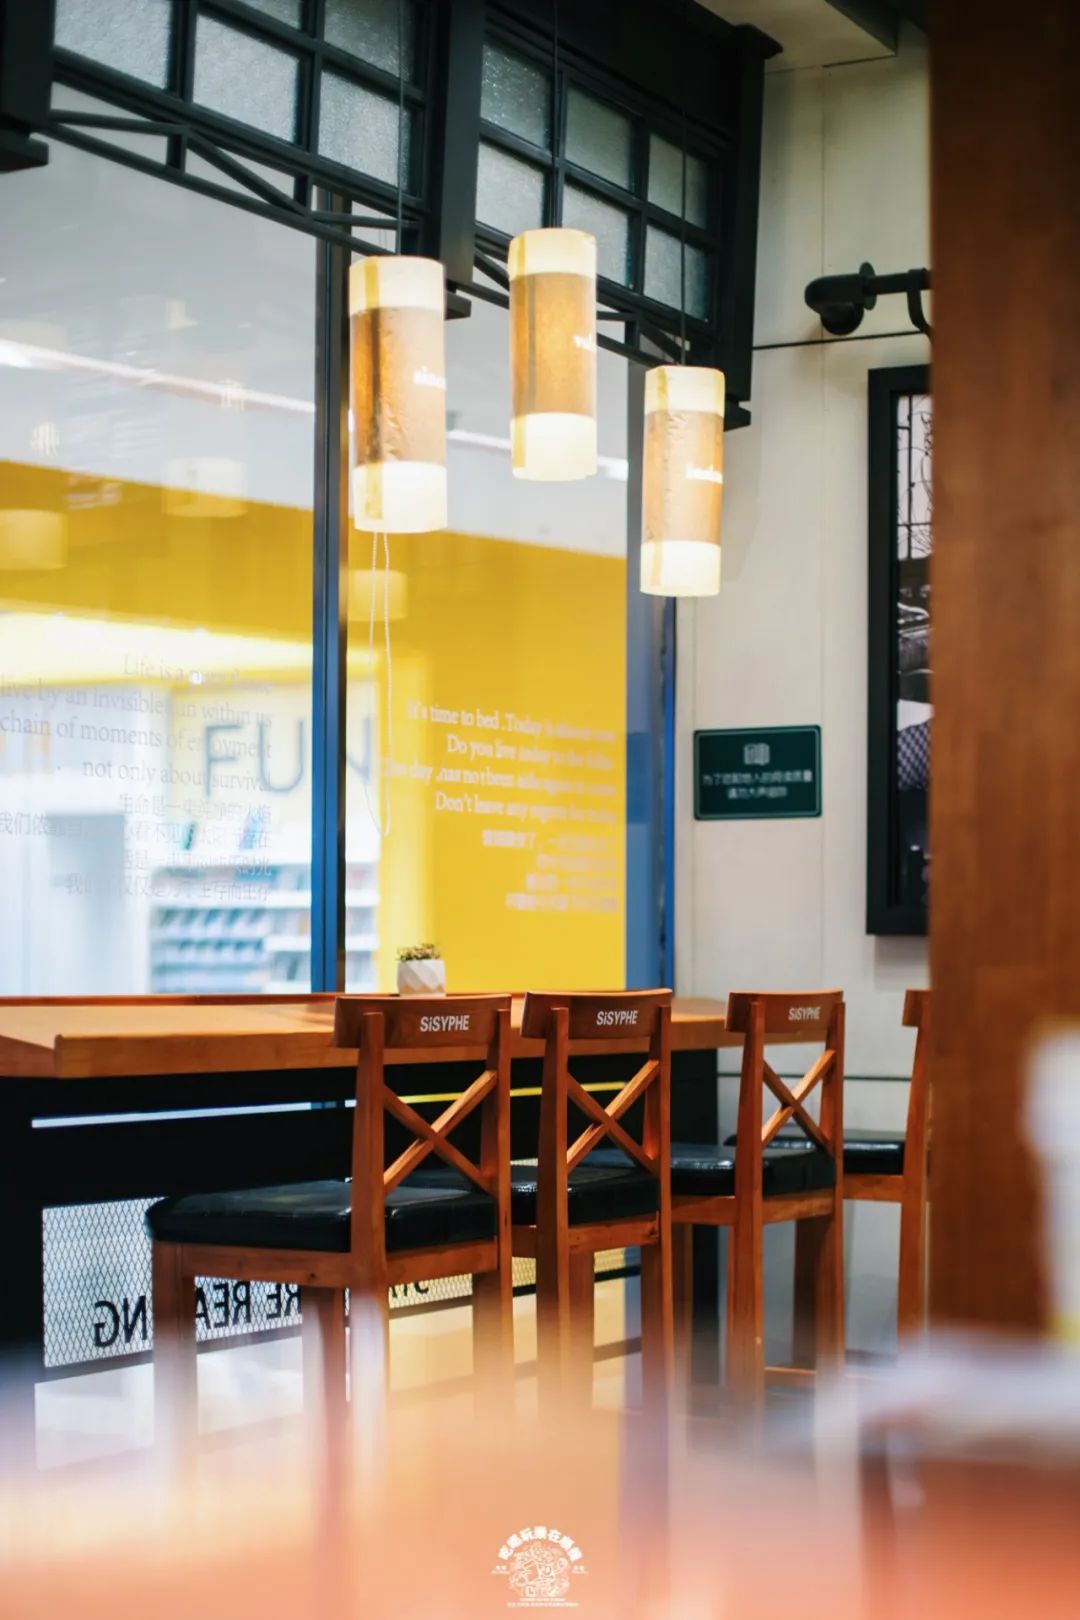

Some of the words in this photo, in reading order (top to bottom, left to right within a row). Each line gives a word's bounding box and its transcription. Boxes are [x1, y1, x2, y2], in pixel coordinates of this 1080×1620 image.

[37, 678, 60, 710] by
[65, 690, 87, 706] an
[93, 686, 164, 715] invisible
[0, 709, 51, 736] chain
[56, 715, 79, 738] of
[80, 723, 163, 748] moments
[447, 733, 467, 754] Do
[82, 759, 113, 779] not
[118, 763, 157, 787] only
[435, 790, 472, 814] Don't
